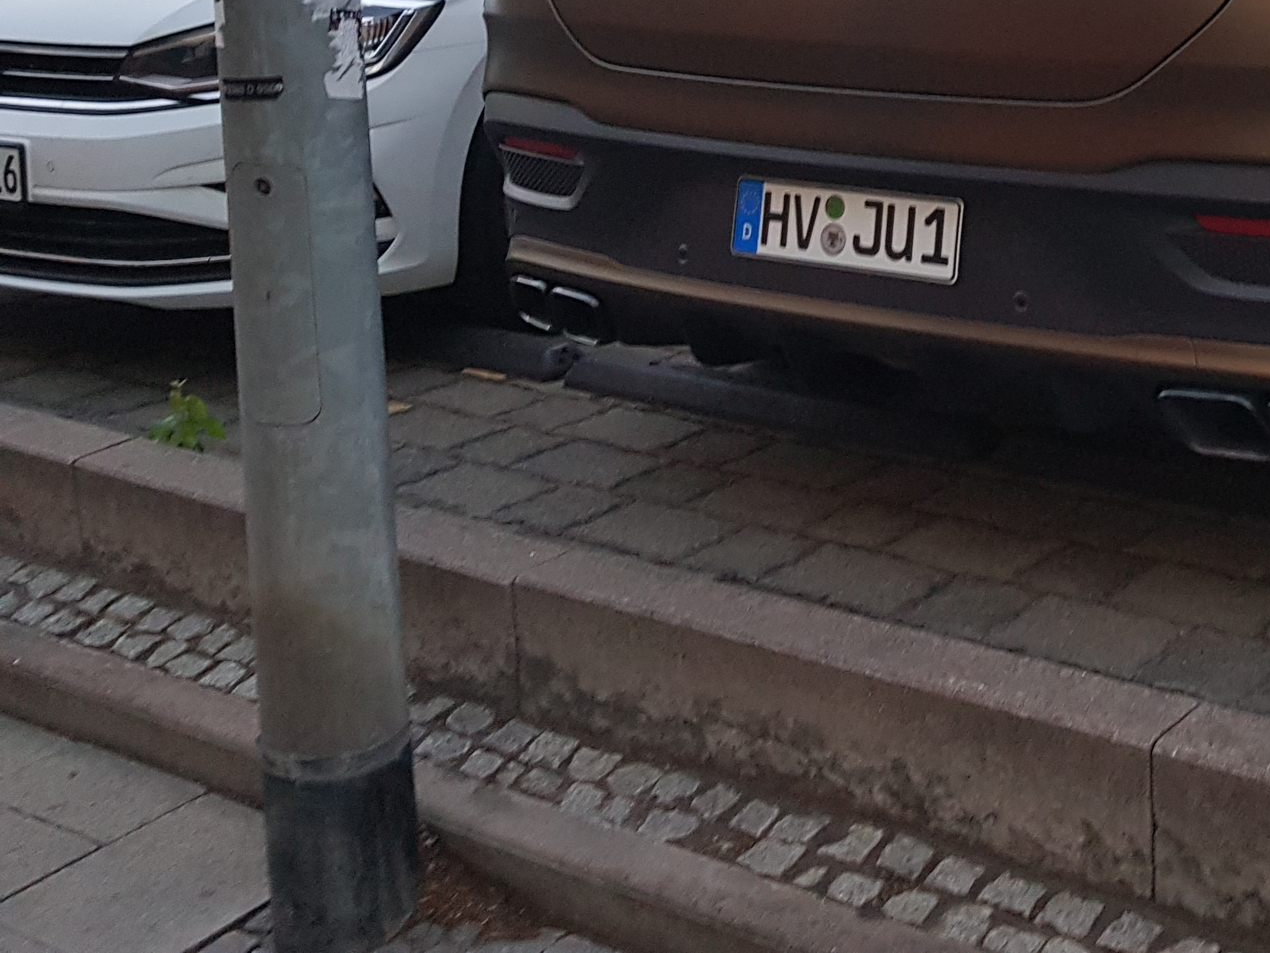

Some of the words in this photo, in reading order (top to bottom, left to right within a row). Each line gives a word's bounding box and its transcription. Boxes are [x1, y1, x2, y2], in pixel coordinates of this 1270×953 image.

[0, 154, 17, 195] 6
[742, 222, 753, 241] D
[760, 190, 822, 251] HV
